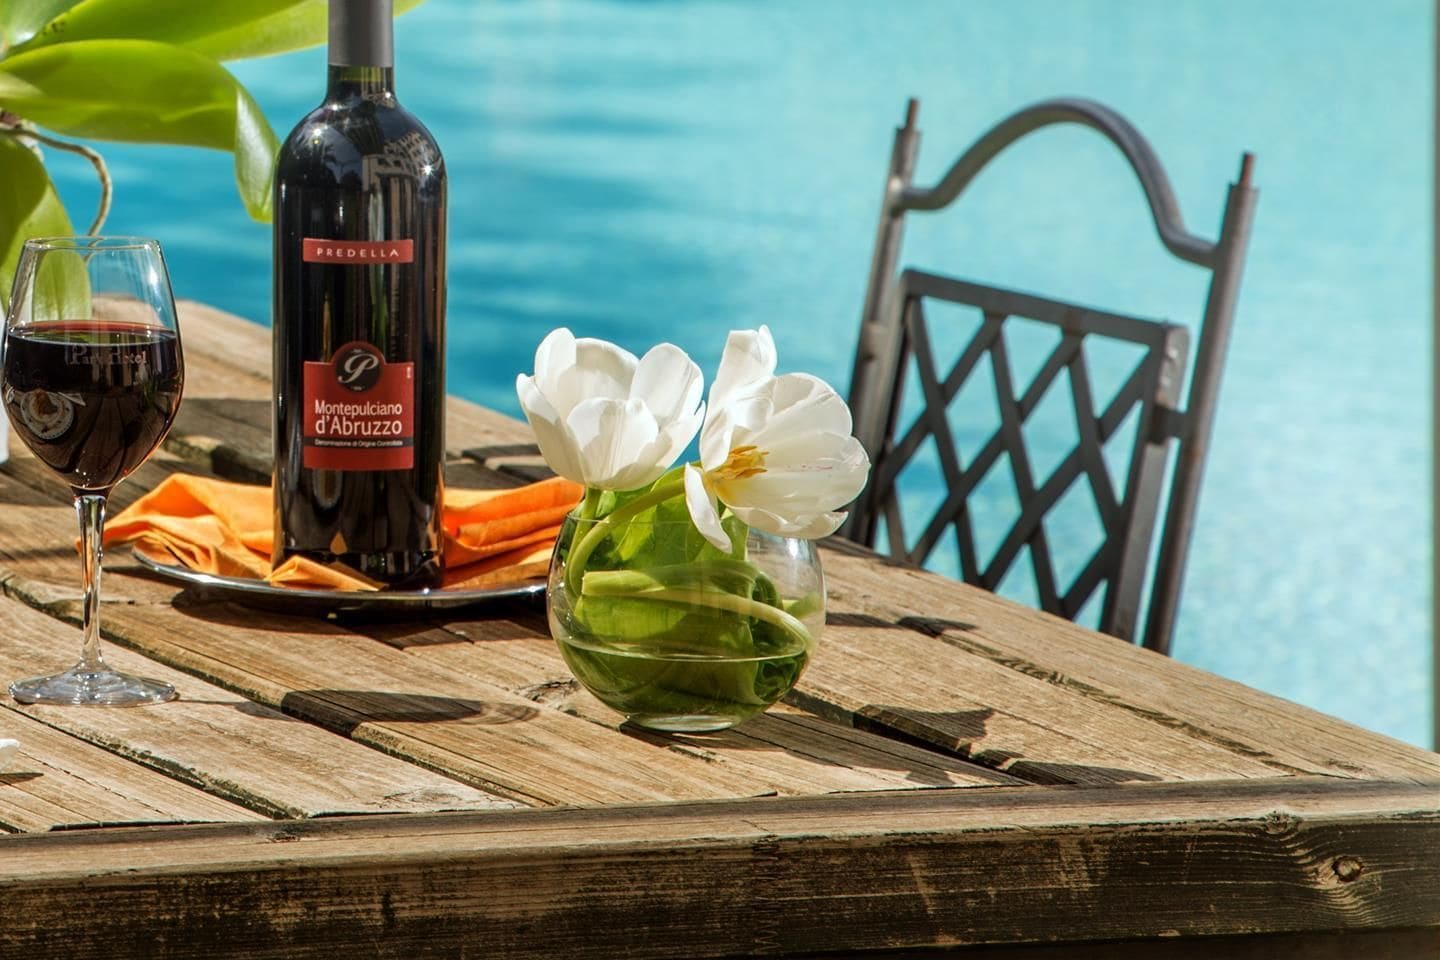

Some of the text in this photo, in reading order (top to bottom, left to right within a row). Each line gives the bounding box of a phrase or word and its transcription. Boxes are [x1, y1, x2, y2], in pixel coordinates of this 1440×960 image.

[317, 247, 400, 258] PREDELLA
[315, 400, 402, 418] Montepulciano
[315, 416, 402, 435] d'Abruzzo
